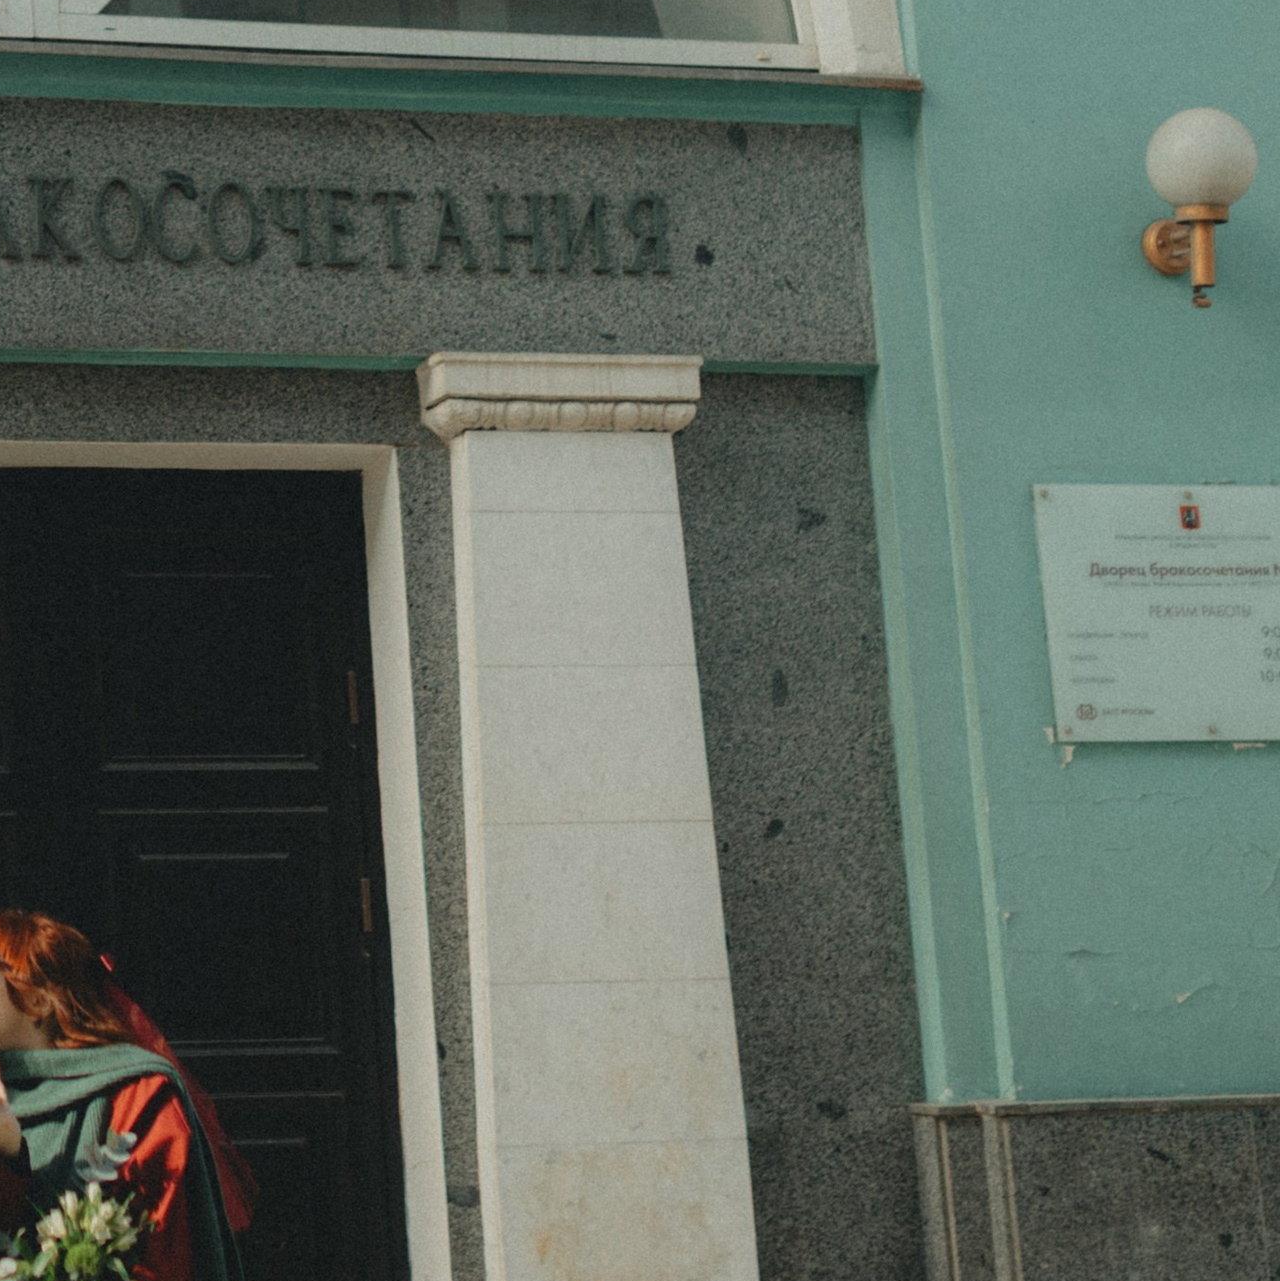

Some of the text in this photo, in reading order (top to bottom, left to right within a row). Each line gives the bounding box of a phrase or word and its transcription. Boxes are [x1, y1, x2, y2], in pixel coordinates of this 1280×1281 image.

[1089, 562, 1147, 579] Дворец
[1149, 562, 1270, 579] бракосочетания
[1149, 604, 1253, 618] РЕЖИМ РАБОТЫ
